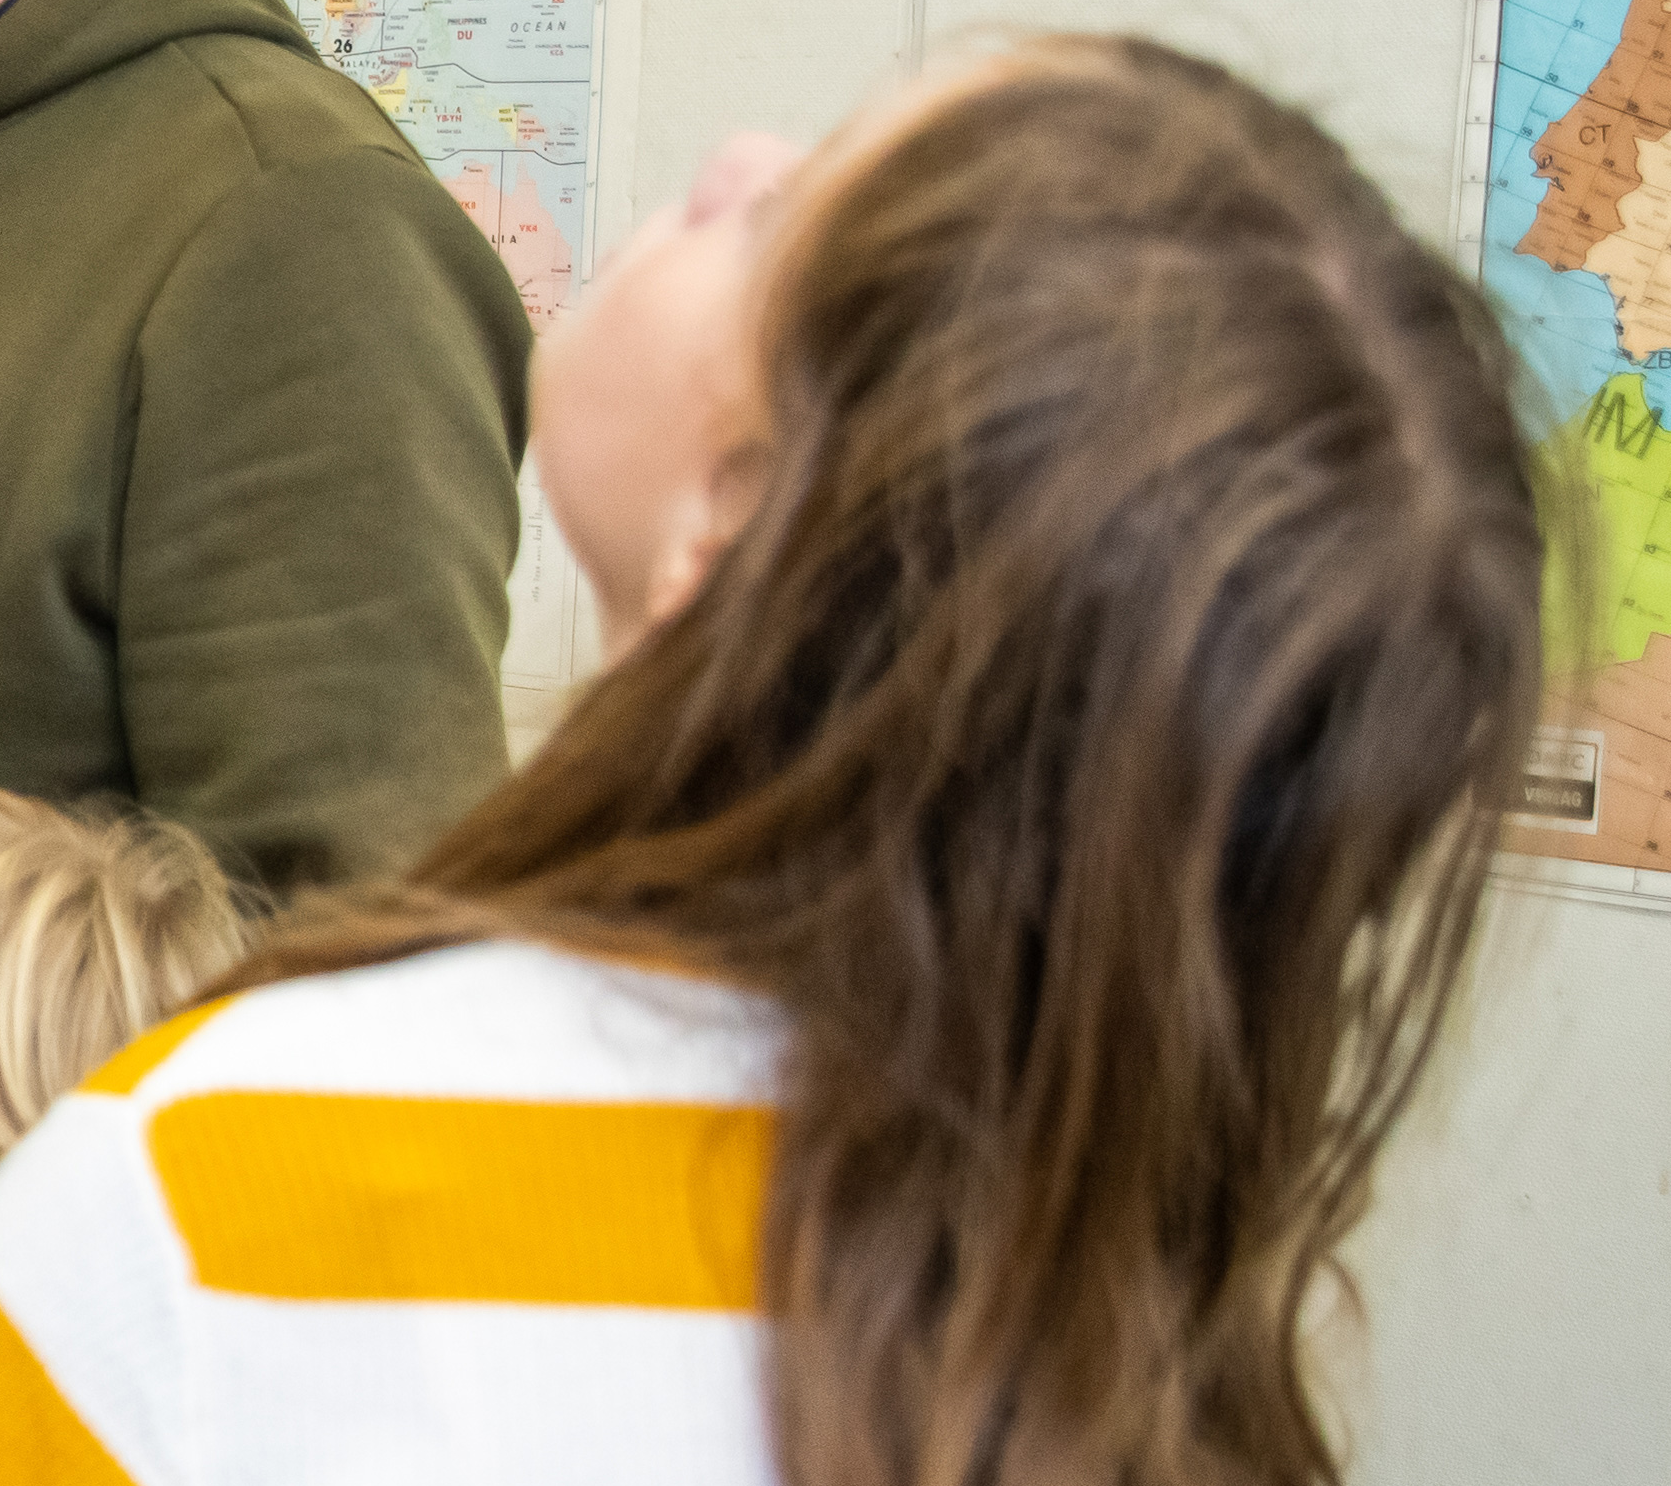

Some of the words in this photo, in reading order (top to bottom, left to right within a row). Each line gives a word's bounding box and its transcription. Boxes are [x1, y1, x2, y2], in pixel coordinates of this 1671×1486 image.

[510, 20, 567, 33] OCEAN
[457, 30, 473, 41] DU
[333, 39, 353, 54] 26
[1579, 123, 1612, 146] CT
